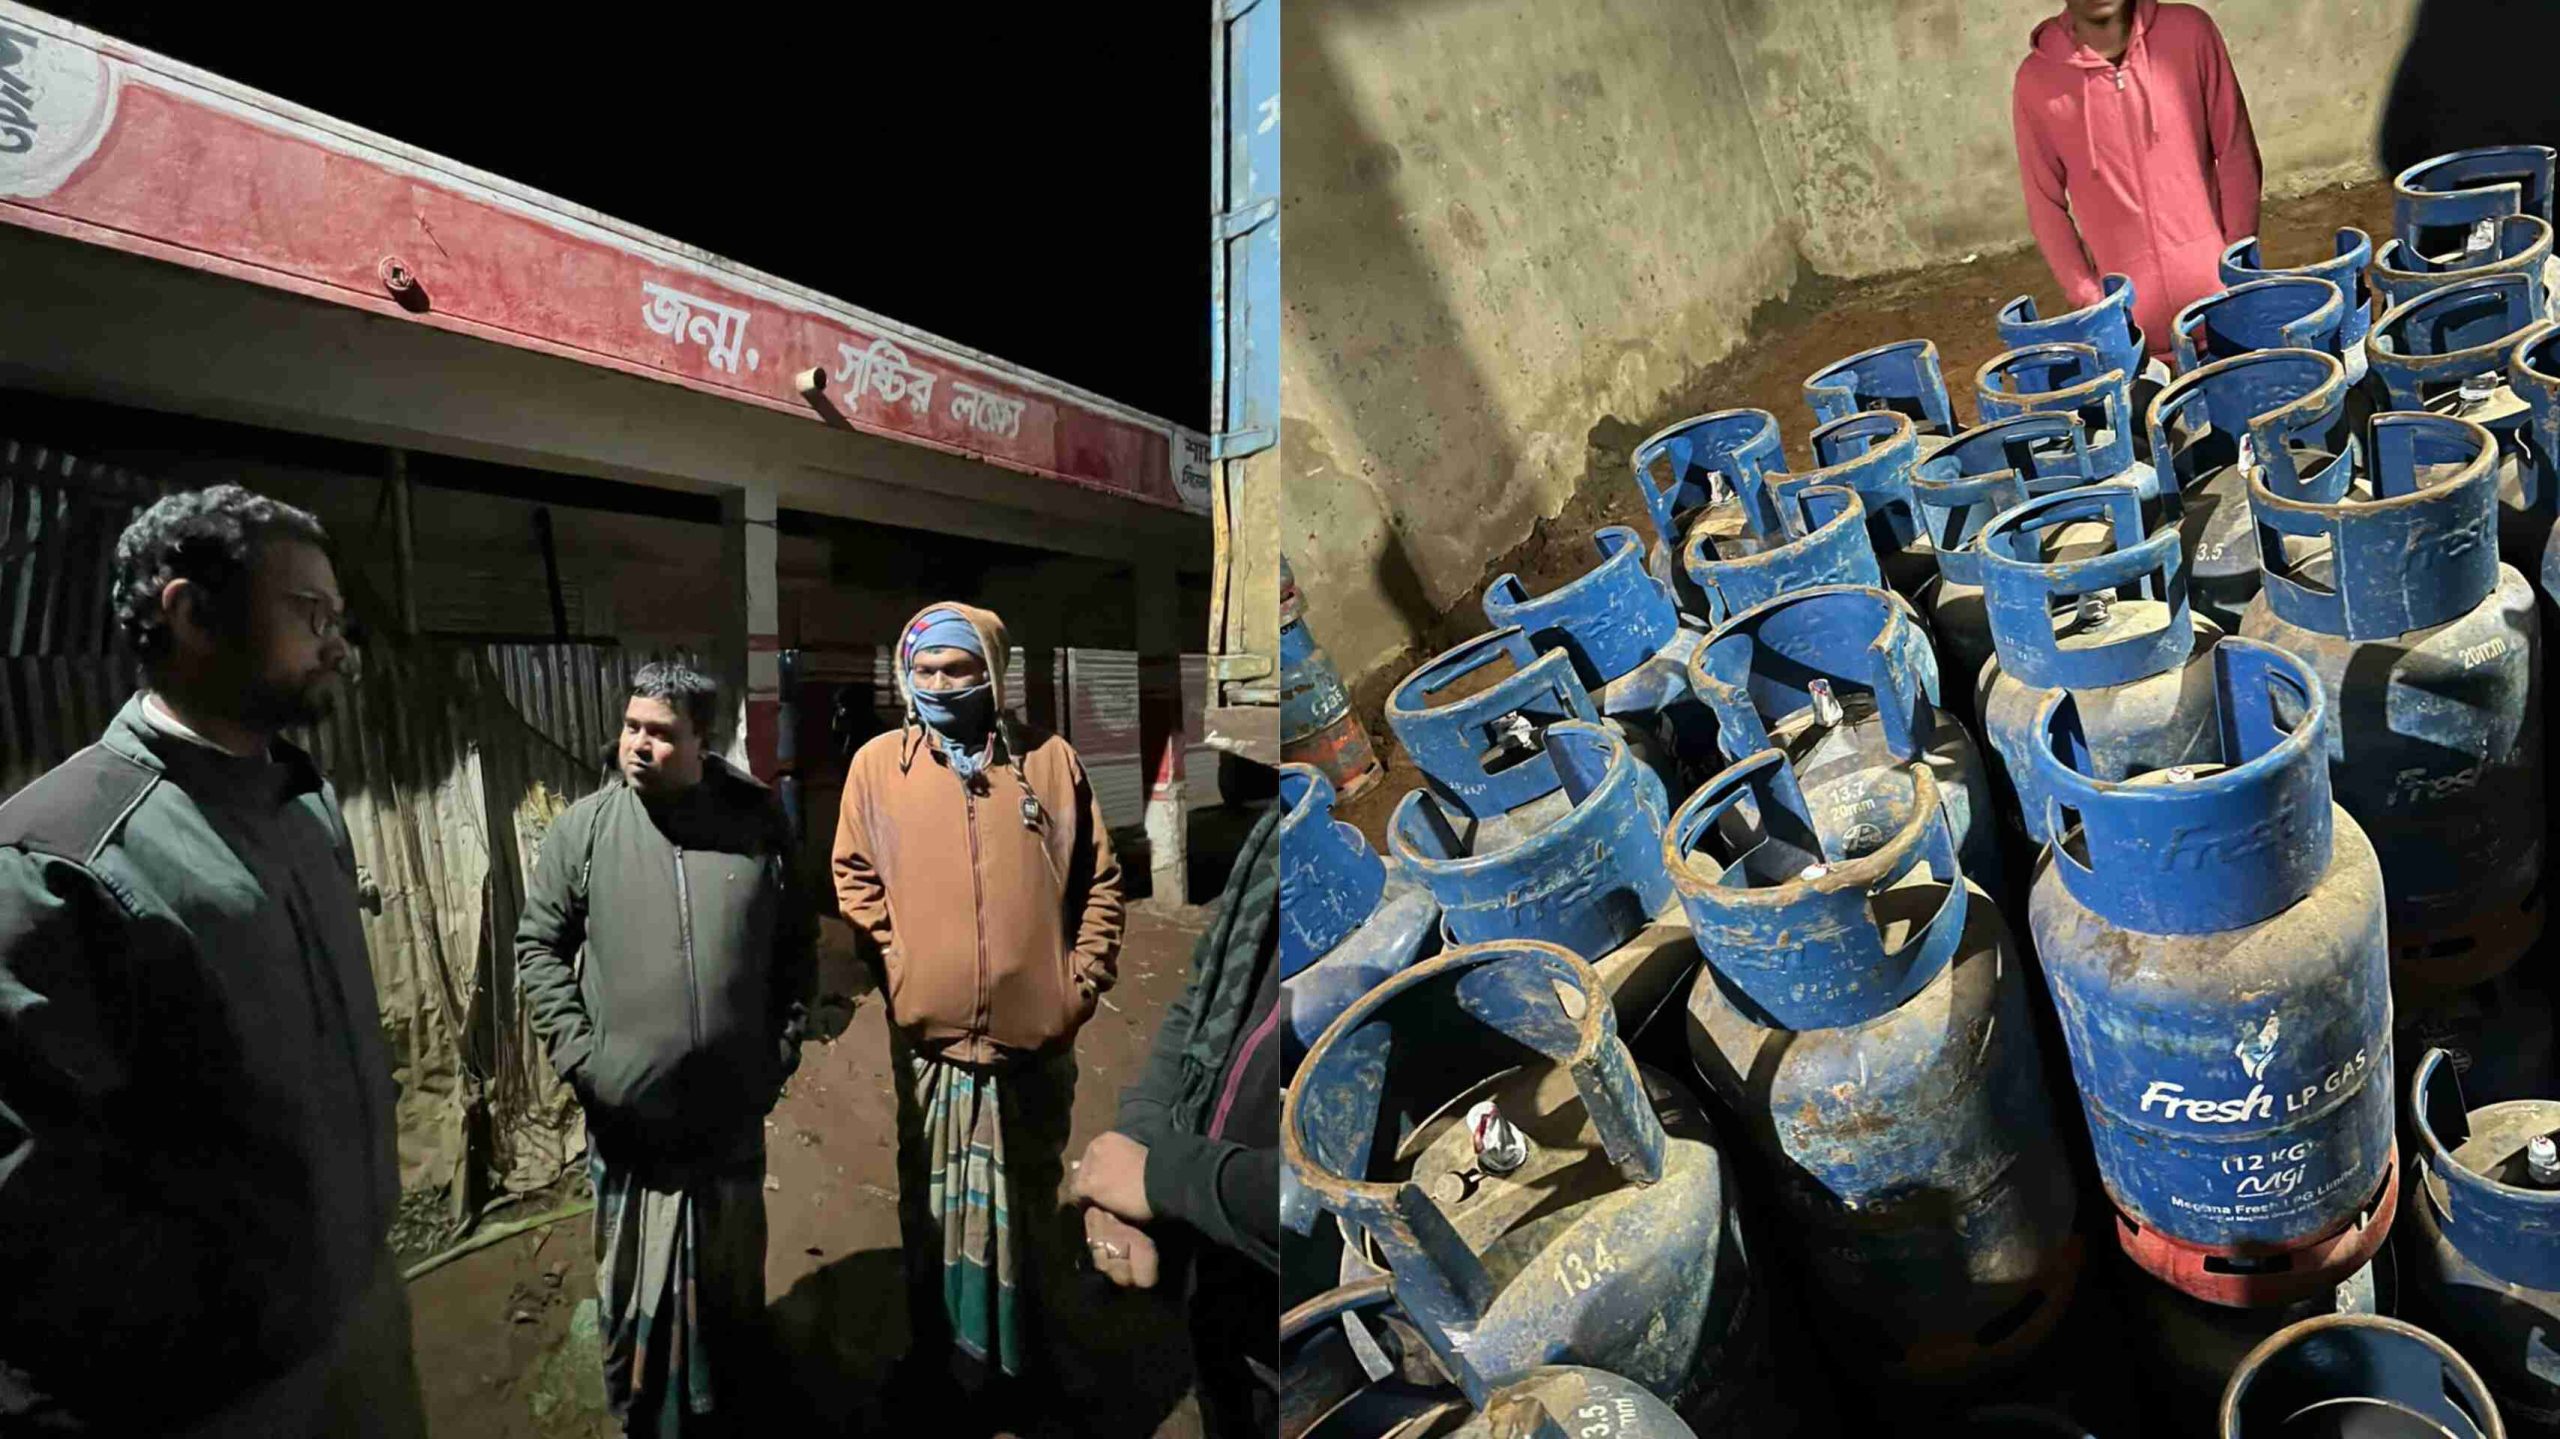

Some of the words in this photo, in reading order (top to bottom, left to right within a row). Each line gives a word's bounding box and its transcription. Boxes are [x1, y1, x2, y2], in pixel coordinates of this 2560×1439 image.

[835, 338, 937, 413] সৃষ্টির
[952, 381, 1026, 439] লক্ষ্যে
[2458, 636, 2507, 670] 20mm
[1831, 799, 1876, 821] 20mm
[2140, 1081, 2273, 1123] Fresh
[2286, 1086, 2318, 1112] LP
[2324, 1048, 2366, 1093] GAS
[1554, 1238, 1616, 1298] 13.4
